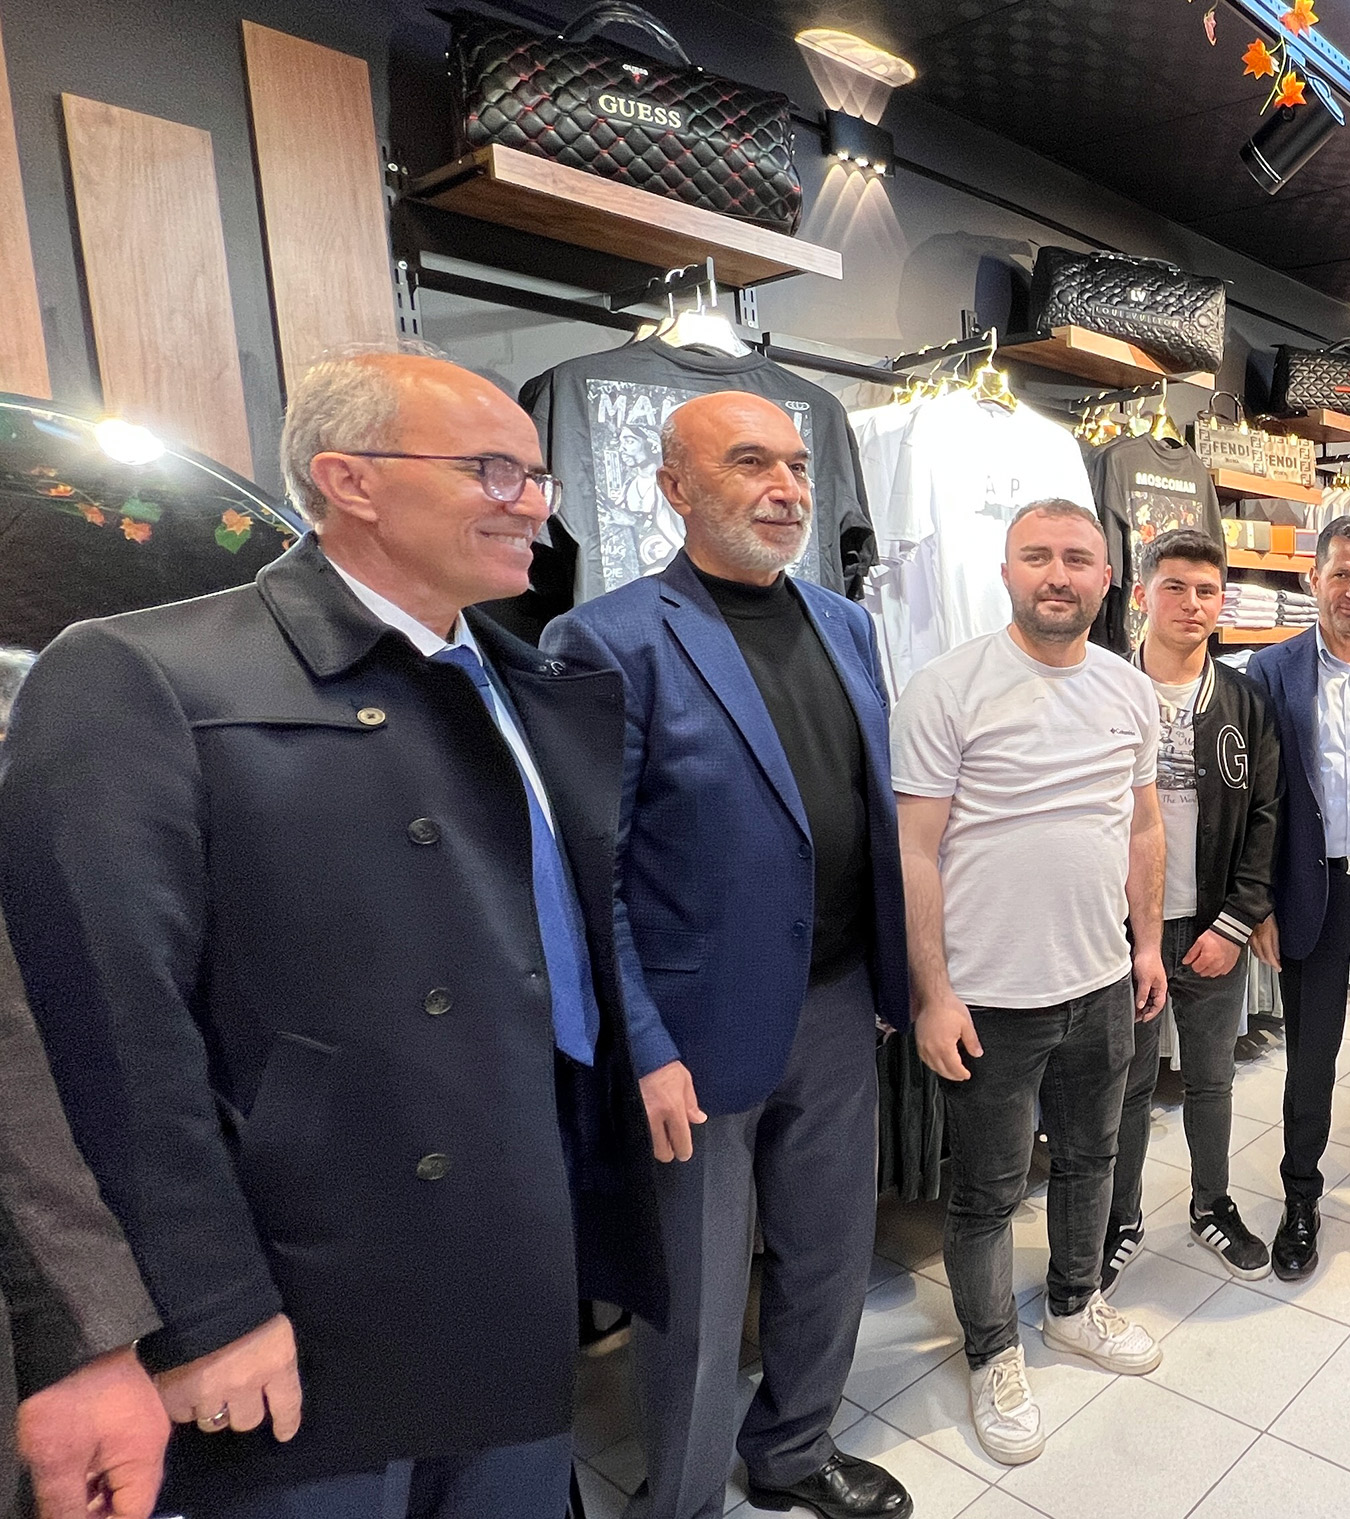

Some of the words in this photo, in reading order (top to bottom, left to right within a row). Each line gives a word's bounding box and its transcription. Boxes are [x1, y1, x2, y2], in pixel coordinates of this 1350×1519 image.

[598, 94, 682, 129] GUESS
[1213, 441, 1250, 457] FENDI
[1216, 724, 1249, 790] G
